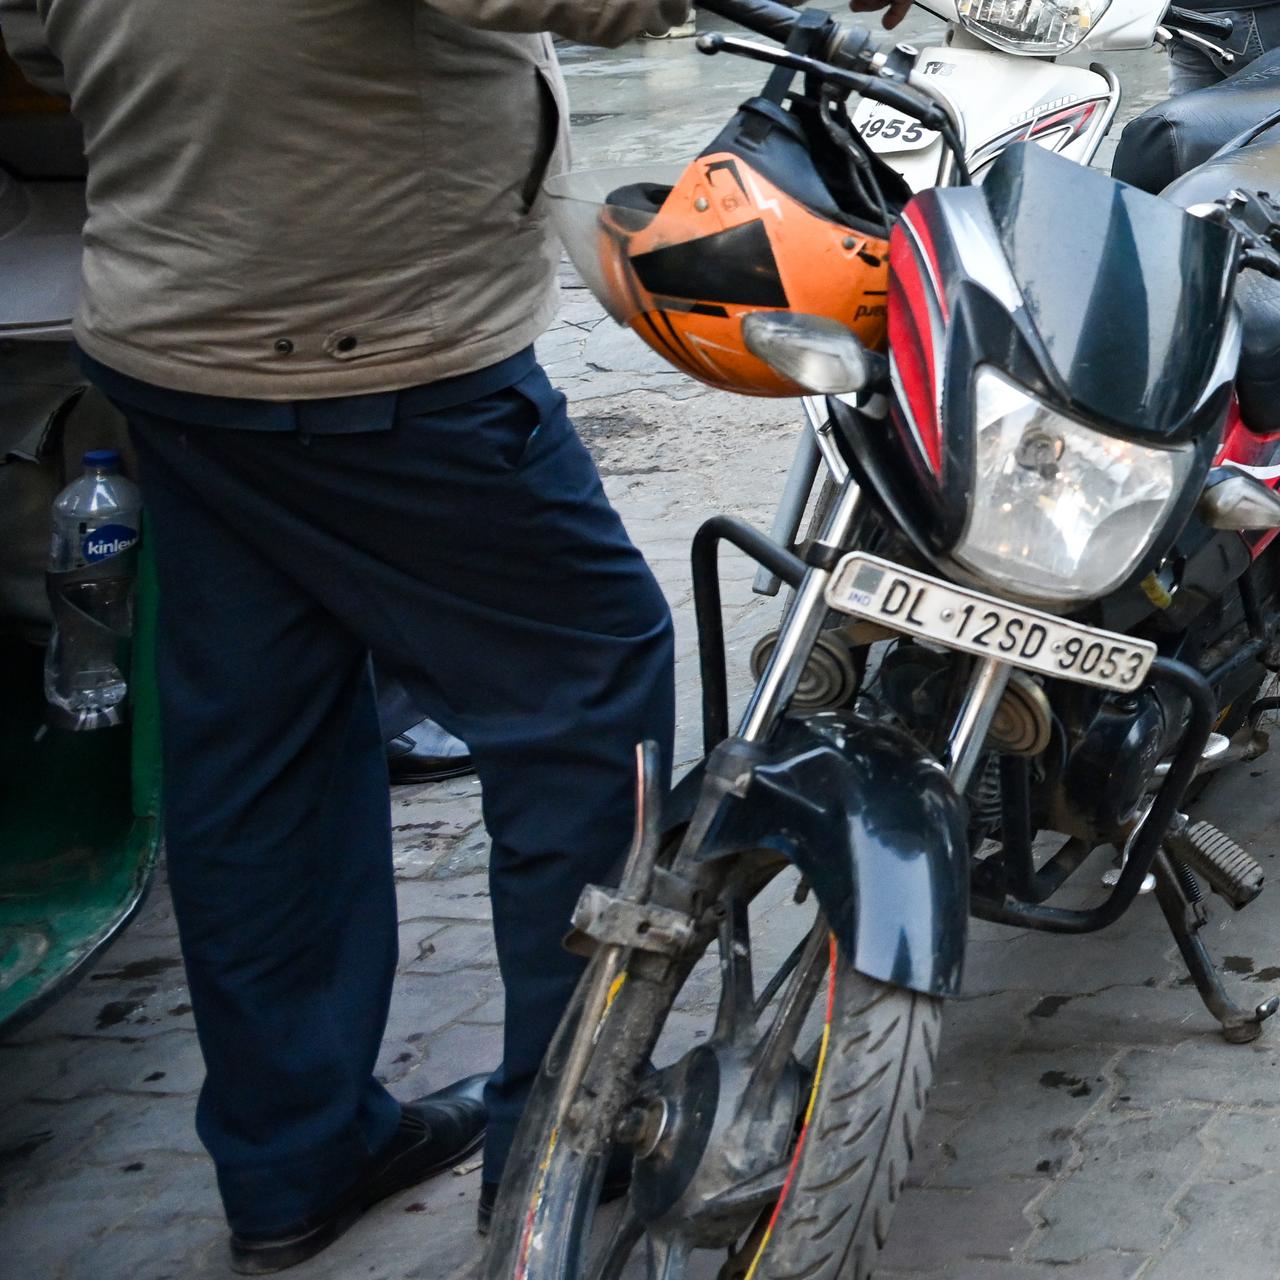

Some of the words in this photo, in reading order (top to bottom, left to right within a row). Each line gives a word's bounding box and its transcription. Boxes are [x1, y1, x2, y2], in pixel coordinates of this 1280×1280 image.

[922, 61, 959, 75] TVS
[858, 118, 924, 144] 1955
[880, 578, 924, 627] DL
[955, 603, 1049, 660] 12SD
[1058, 636, 1145, 686] 9053
